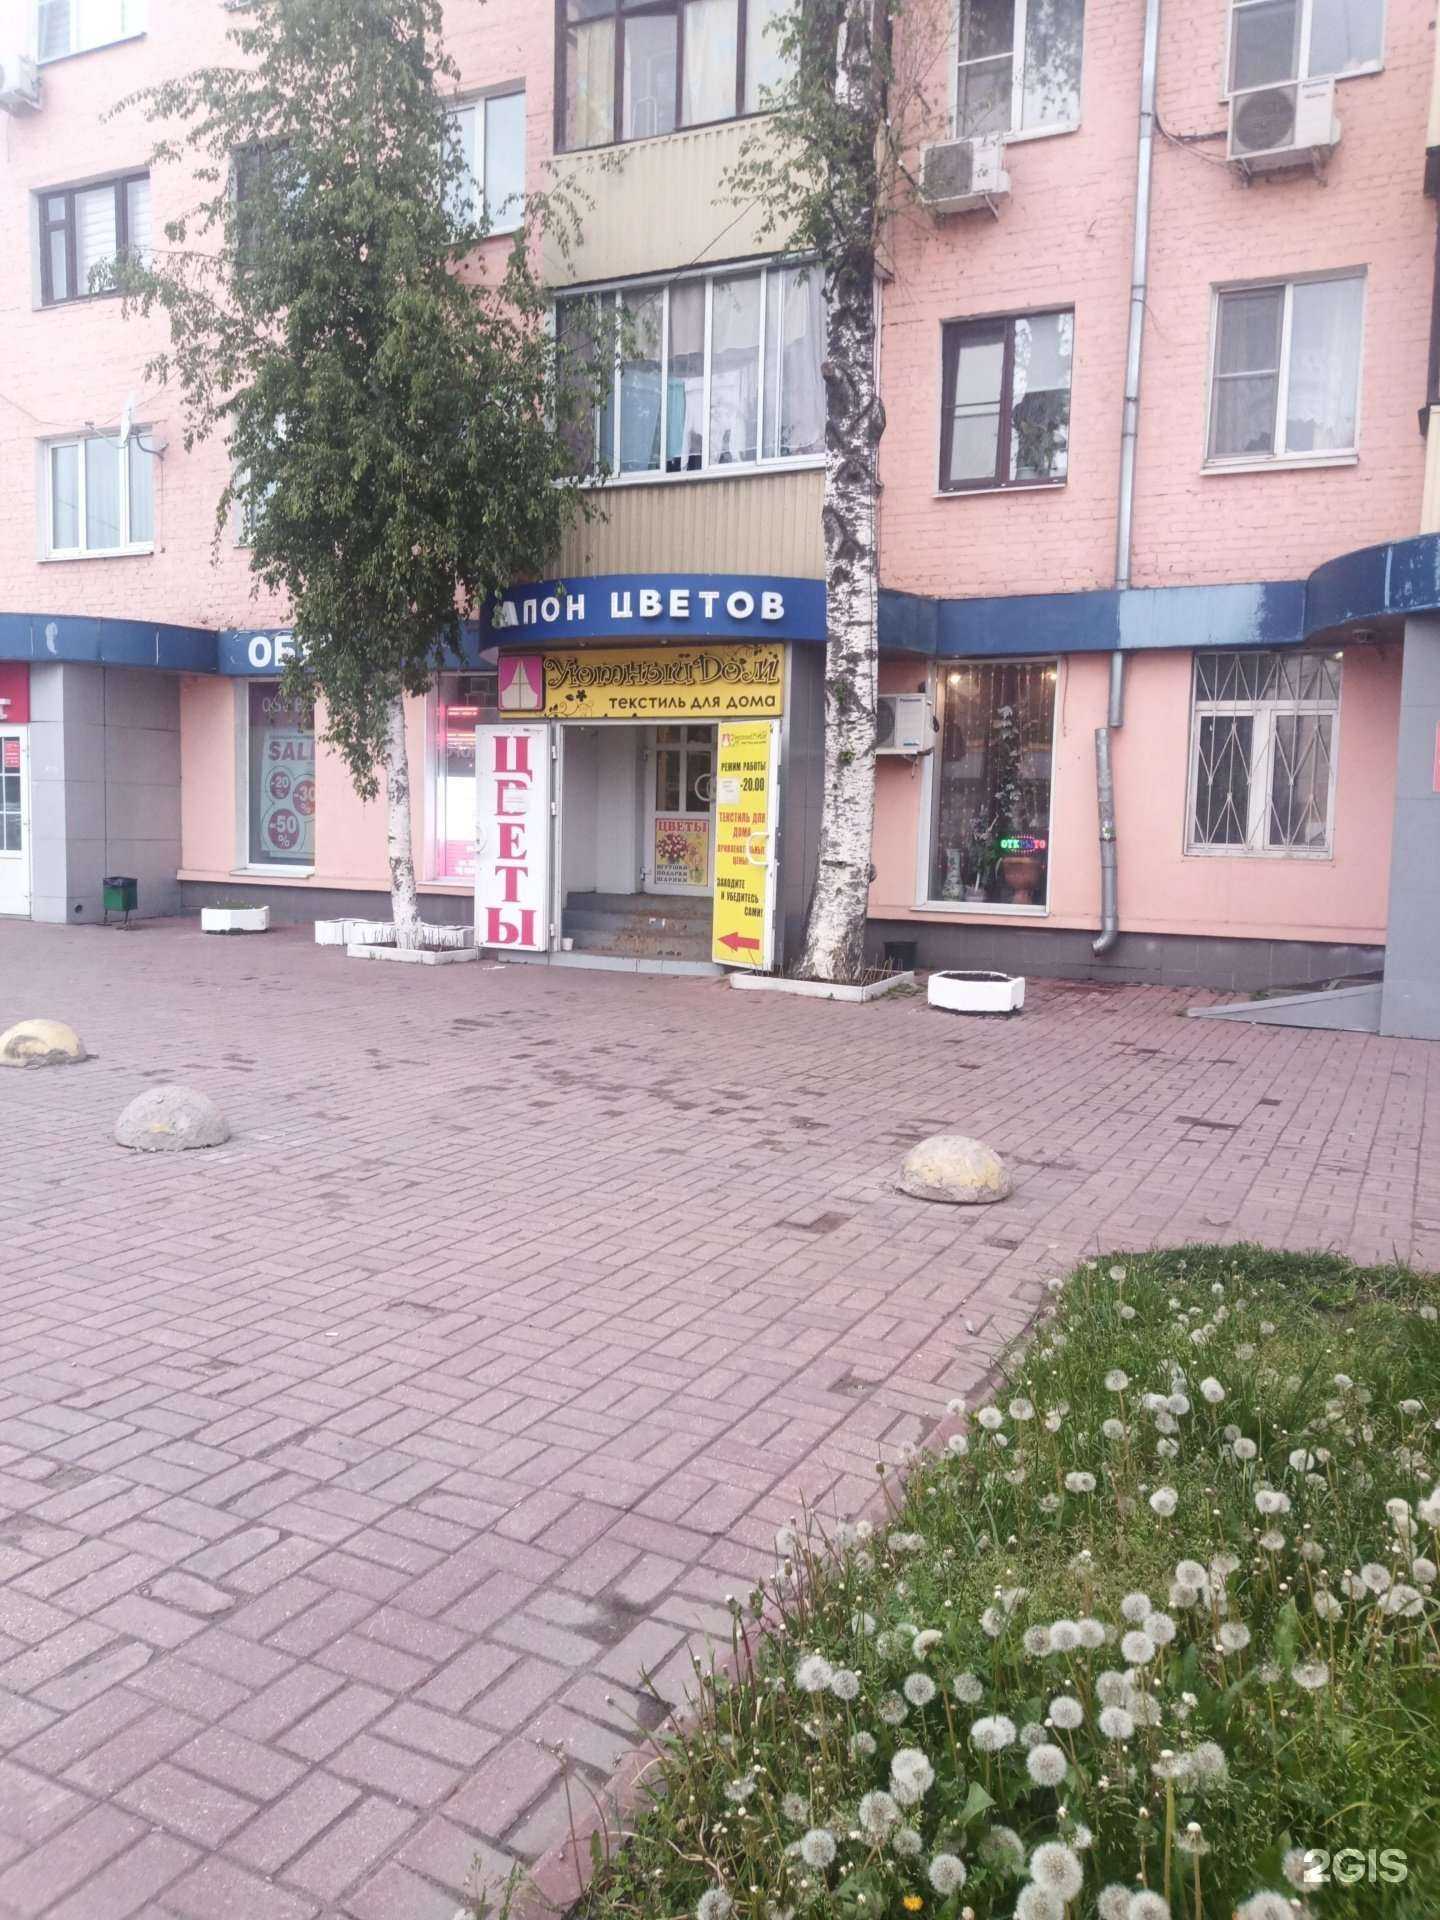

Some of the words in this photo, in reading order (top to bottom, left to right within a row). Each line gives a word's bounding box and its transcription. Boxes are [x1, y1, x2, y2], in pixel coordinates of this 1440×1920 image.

[611, 589, 785, 620] ЦВЕТОВ
[609, 697, 686, 709] текстиль
[691, 696, 721, 710] для
[726, 695, 776, 709] дома
[721, 762, 741, 772] РЕЖИМ
[743, 761, 767, 772] РАБОТЫ
[719, 812, 750, 823] ТЕКСТИЛЬ
[752, 813, 766, 824] ДЛЯ
[269, 816, 297, 833] -50
[658, 821, 707, 833] ЦВЕТЫ
[733, 827, 751, 839] ДОМА
[717, 878, 745, 889] ЗАХОДИТЕ
[727, 892, 759, 904] УБЕДИТЕСЬ
